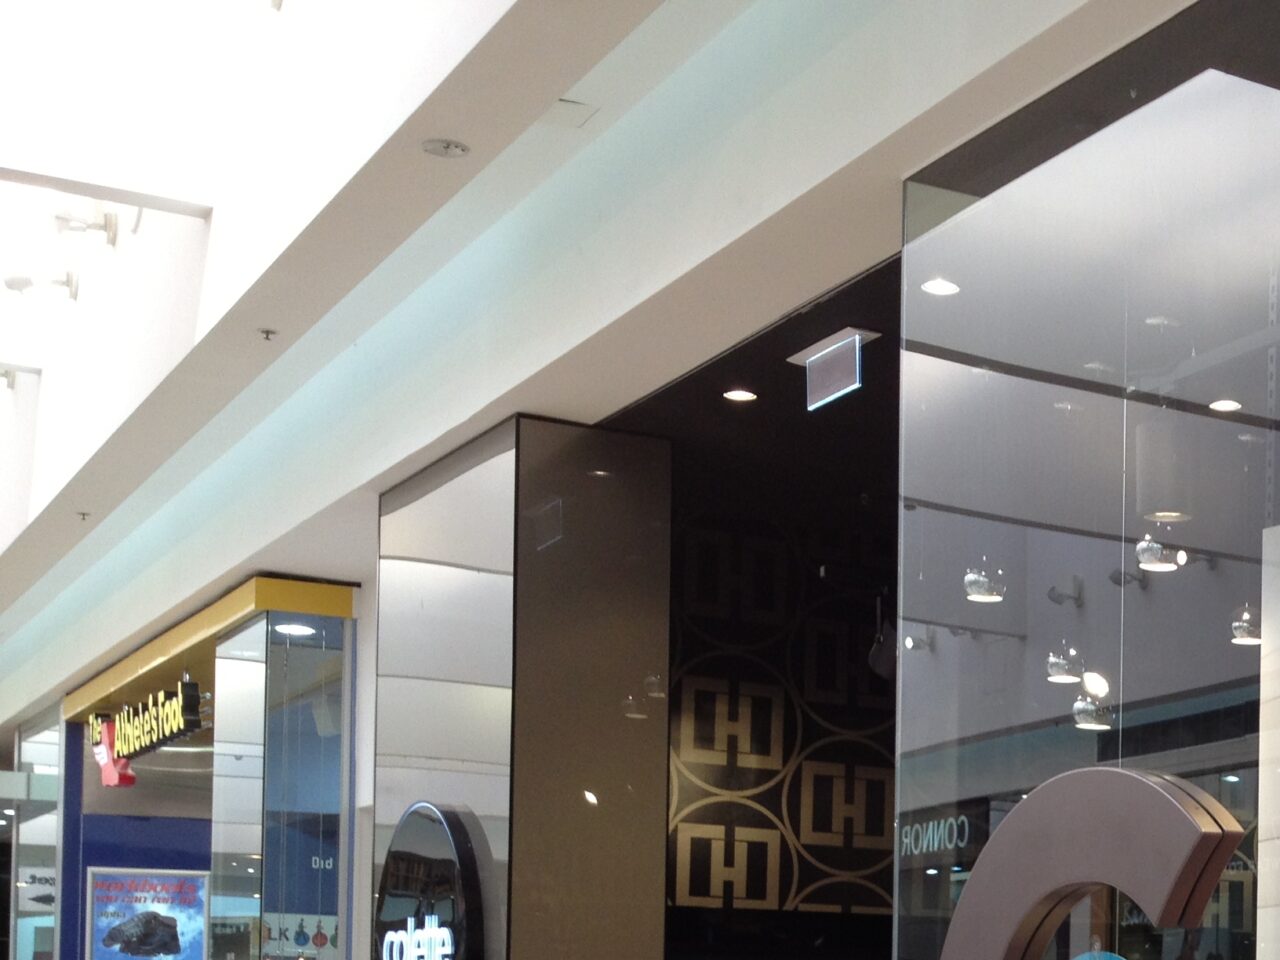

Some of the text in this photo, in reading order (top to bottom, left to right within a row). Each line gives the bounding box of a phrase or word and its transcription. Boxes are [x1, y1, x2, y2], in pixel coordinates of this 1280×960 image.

[89, 680, 185, 760] The Athlete's Foot
